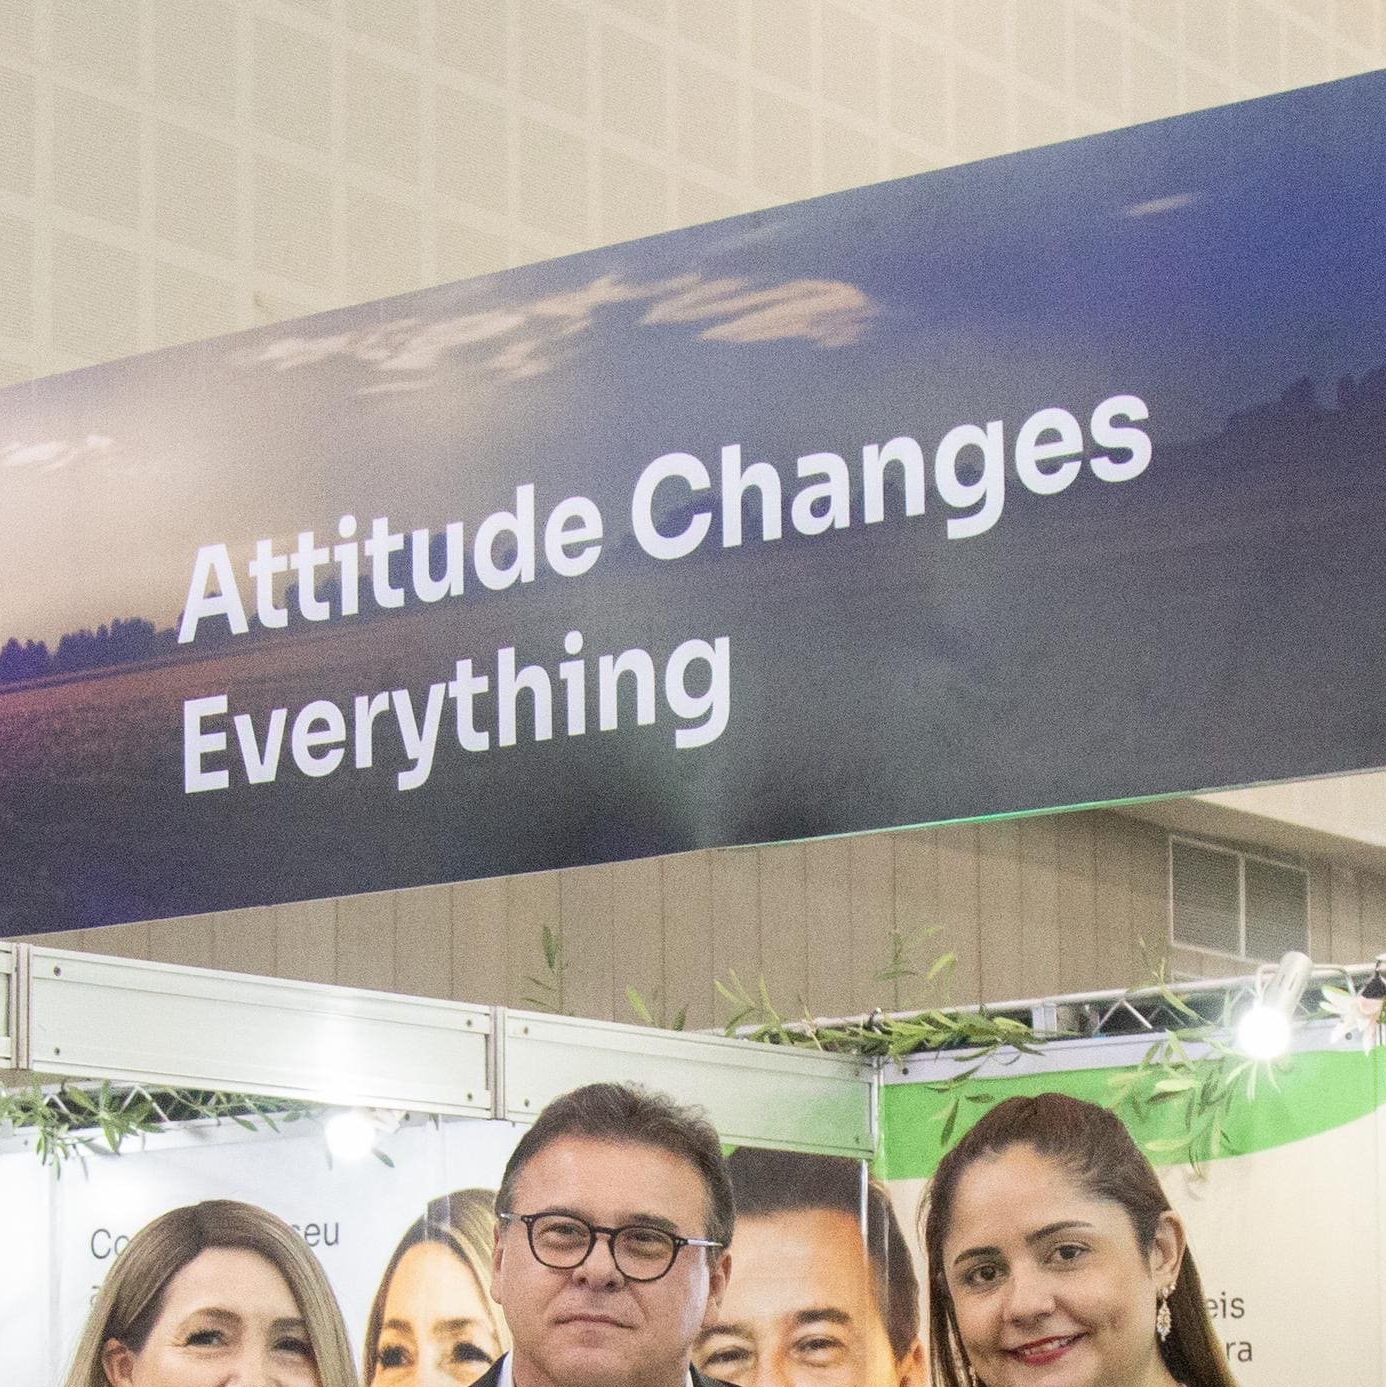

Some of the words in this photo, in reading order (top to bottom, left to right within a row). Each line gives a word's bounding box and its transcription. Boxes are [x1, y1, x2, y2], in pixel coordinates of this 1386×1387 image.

[177, 483, 603, 644] Attitude
[631, 395, 1153, 560] Changes
[185, 630, 732, 795] Everything
